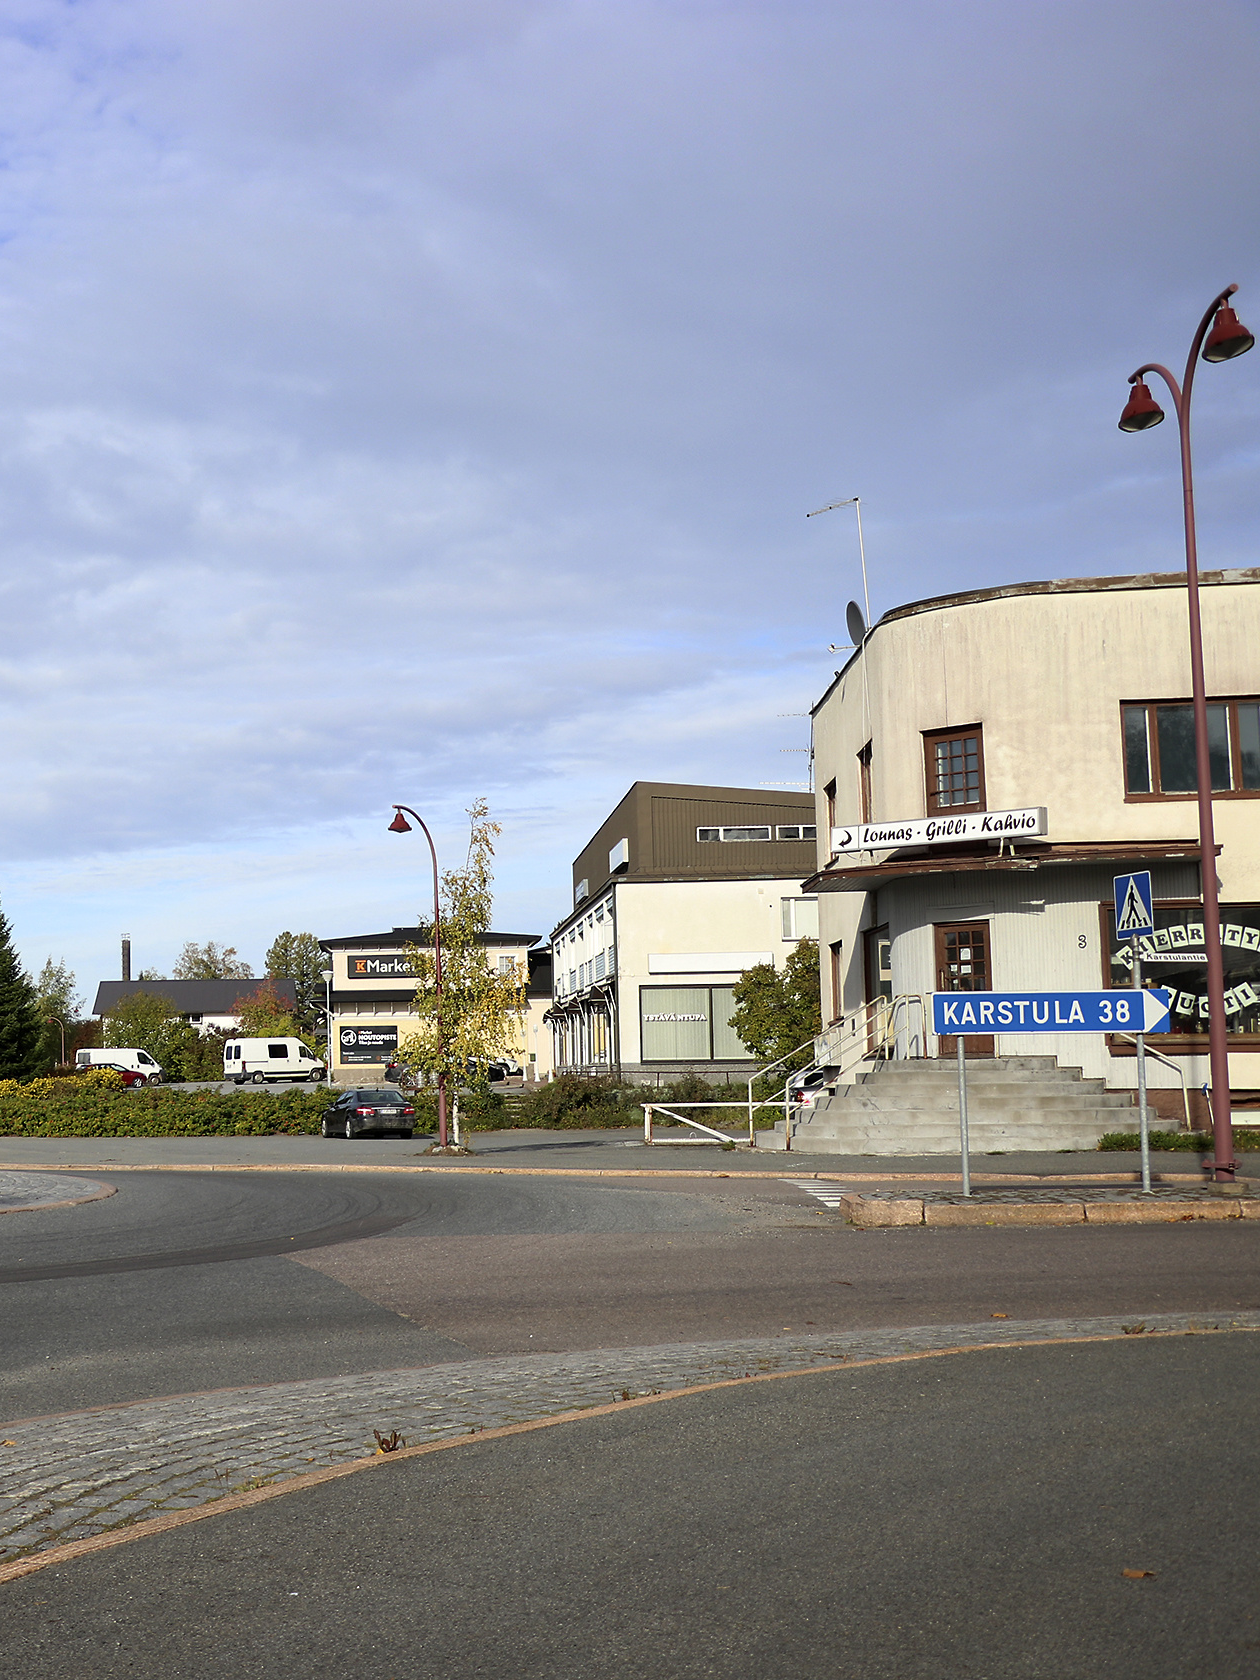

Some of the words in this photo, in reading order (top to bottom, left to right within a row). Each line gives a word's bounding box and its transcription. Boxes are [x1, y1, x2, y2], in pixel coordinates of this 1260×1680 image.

[863, 828, 913, 843] Lounas
[925, 819, 967, 841] Grilli
[981, 813, 1036, 832] Kahvio
[1078, 934, 1087, 949] 3
[1120, 928, 1260, 965] KIERRTY
[1146, 952, 1206, 961] Karstulantie
[943, 1000, 1085, 1025] KARSTULA
[1098, 999, 1131, 1024] 38
[1168, 989, 1251, 1013] UOTI
